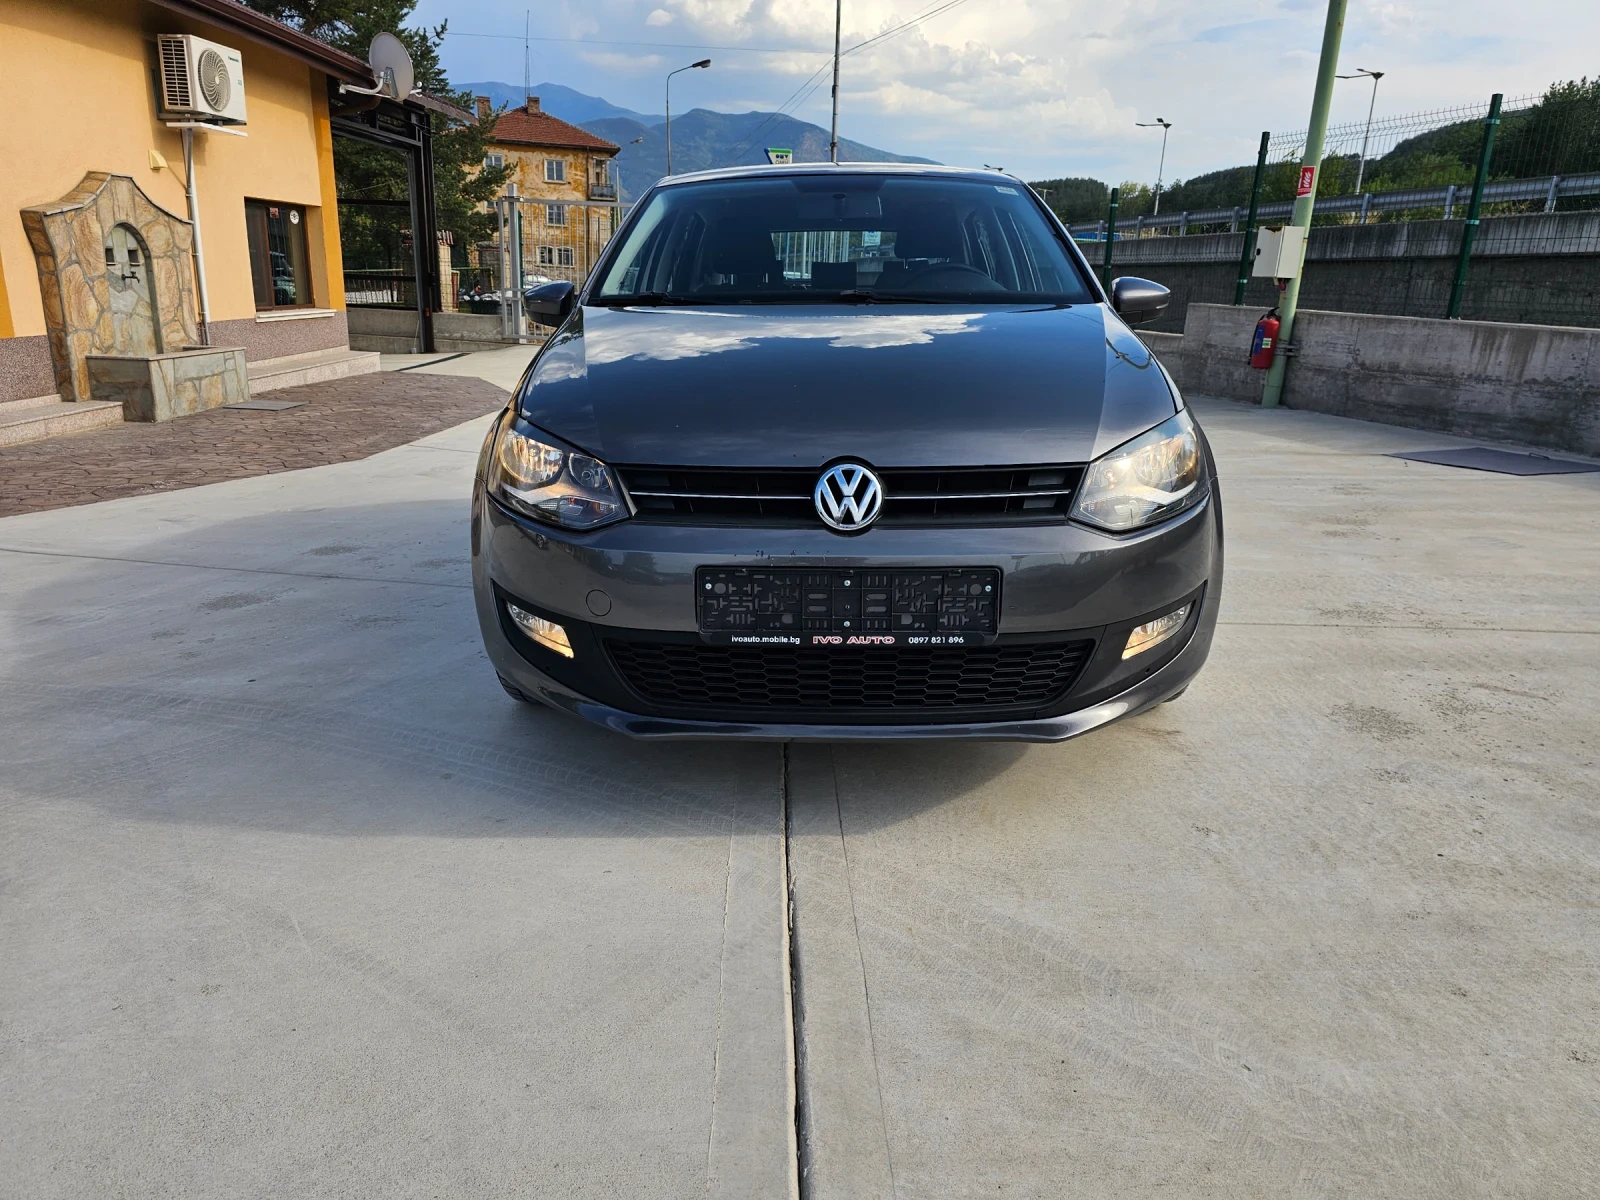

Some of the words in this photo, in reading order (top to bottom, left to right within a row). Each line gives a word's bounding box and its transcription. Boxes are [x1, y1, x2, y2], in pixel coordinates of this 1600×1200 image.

[817, 466, 880, 528] VW
[731, 635, 801, 645] ivoauto.mobile.bg
[812, 635, 843, 645] IVO
[846, 635, 896, 645] AUTO
[908, 636, 929, 645] 0897
[931, 636, 946, 645] 821
[948, 636, 965, 645] 896
